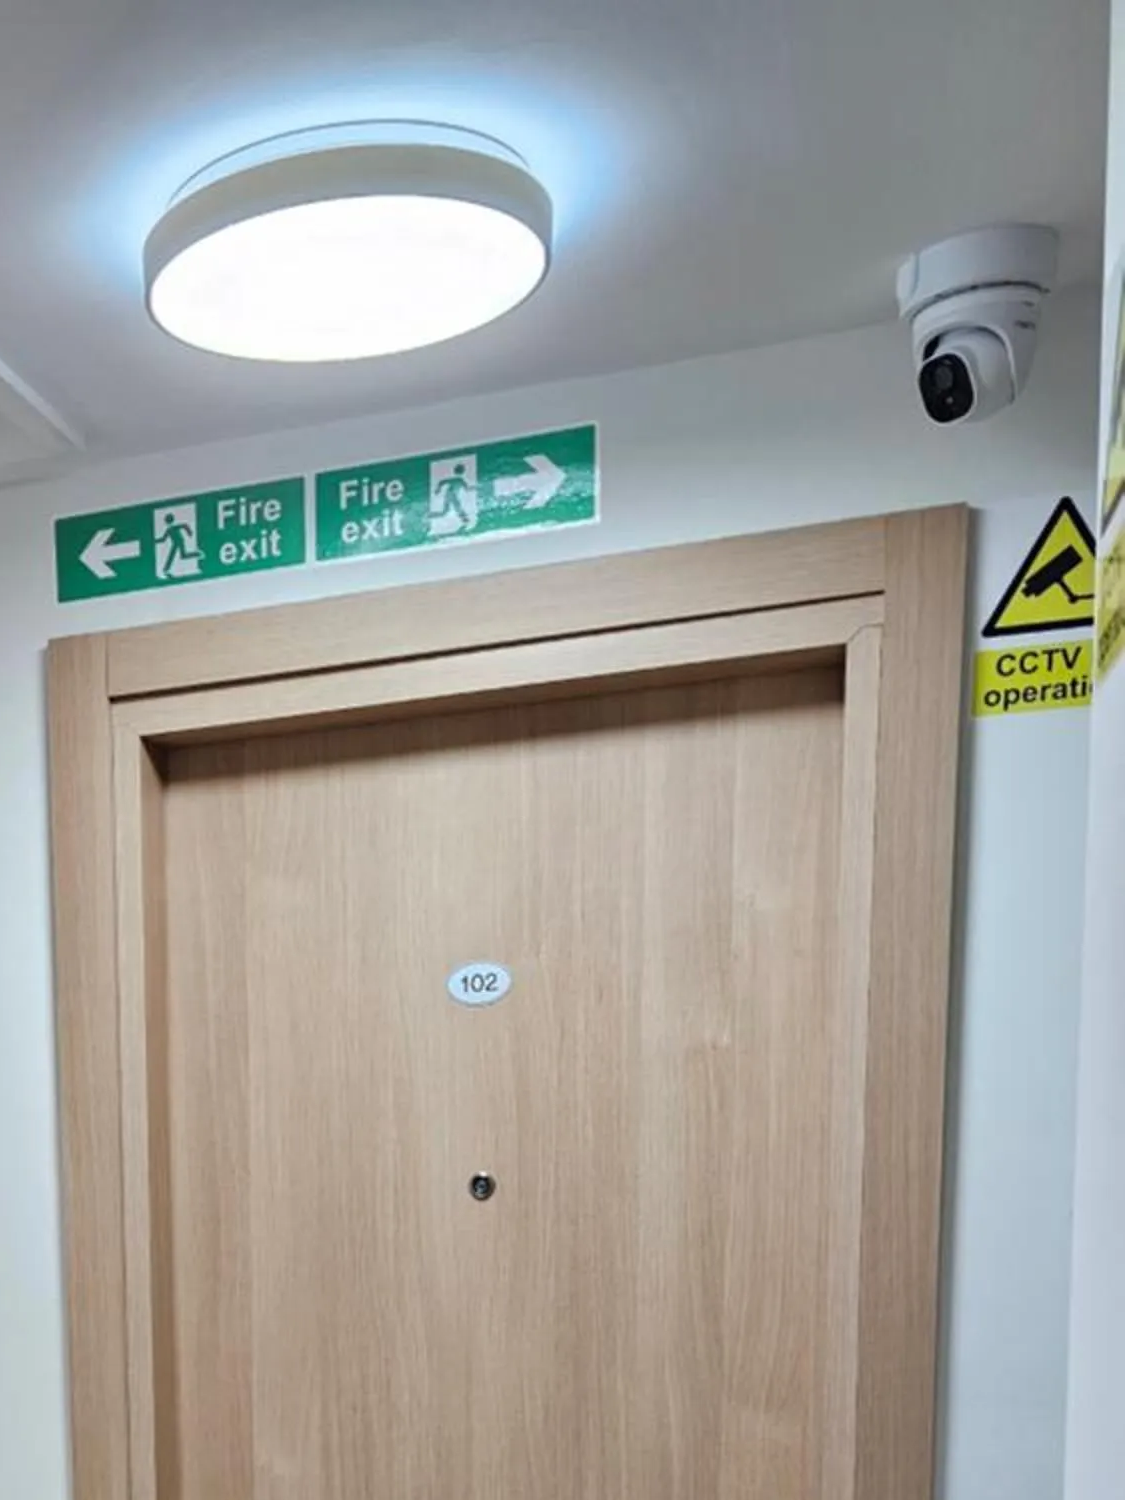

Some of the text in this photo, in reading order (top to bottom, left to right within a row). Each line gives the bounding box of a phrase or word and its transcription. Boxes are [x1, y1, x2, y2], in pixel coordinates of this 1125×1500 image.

[339, 478, 403, 511] Fire
[216, 495, 282, 530] Fire
[341, 510, 403, 545] exit
[218, 531, 282, 565] exit
[995, 646, 1082, 677] CCTV
[984, 677, 1093, 711] operati
[461, 972, 499, 993] 102
